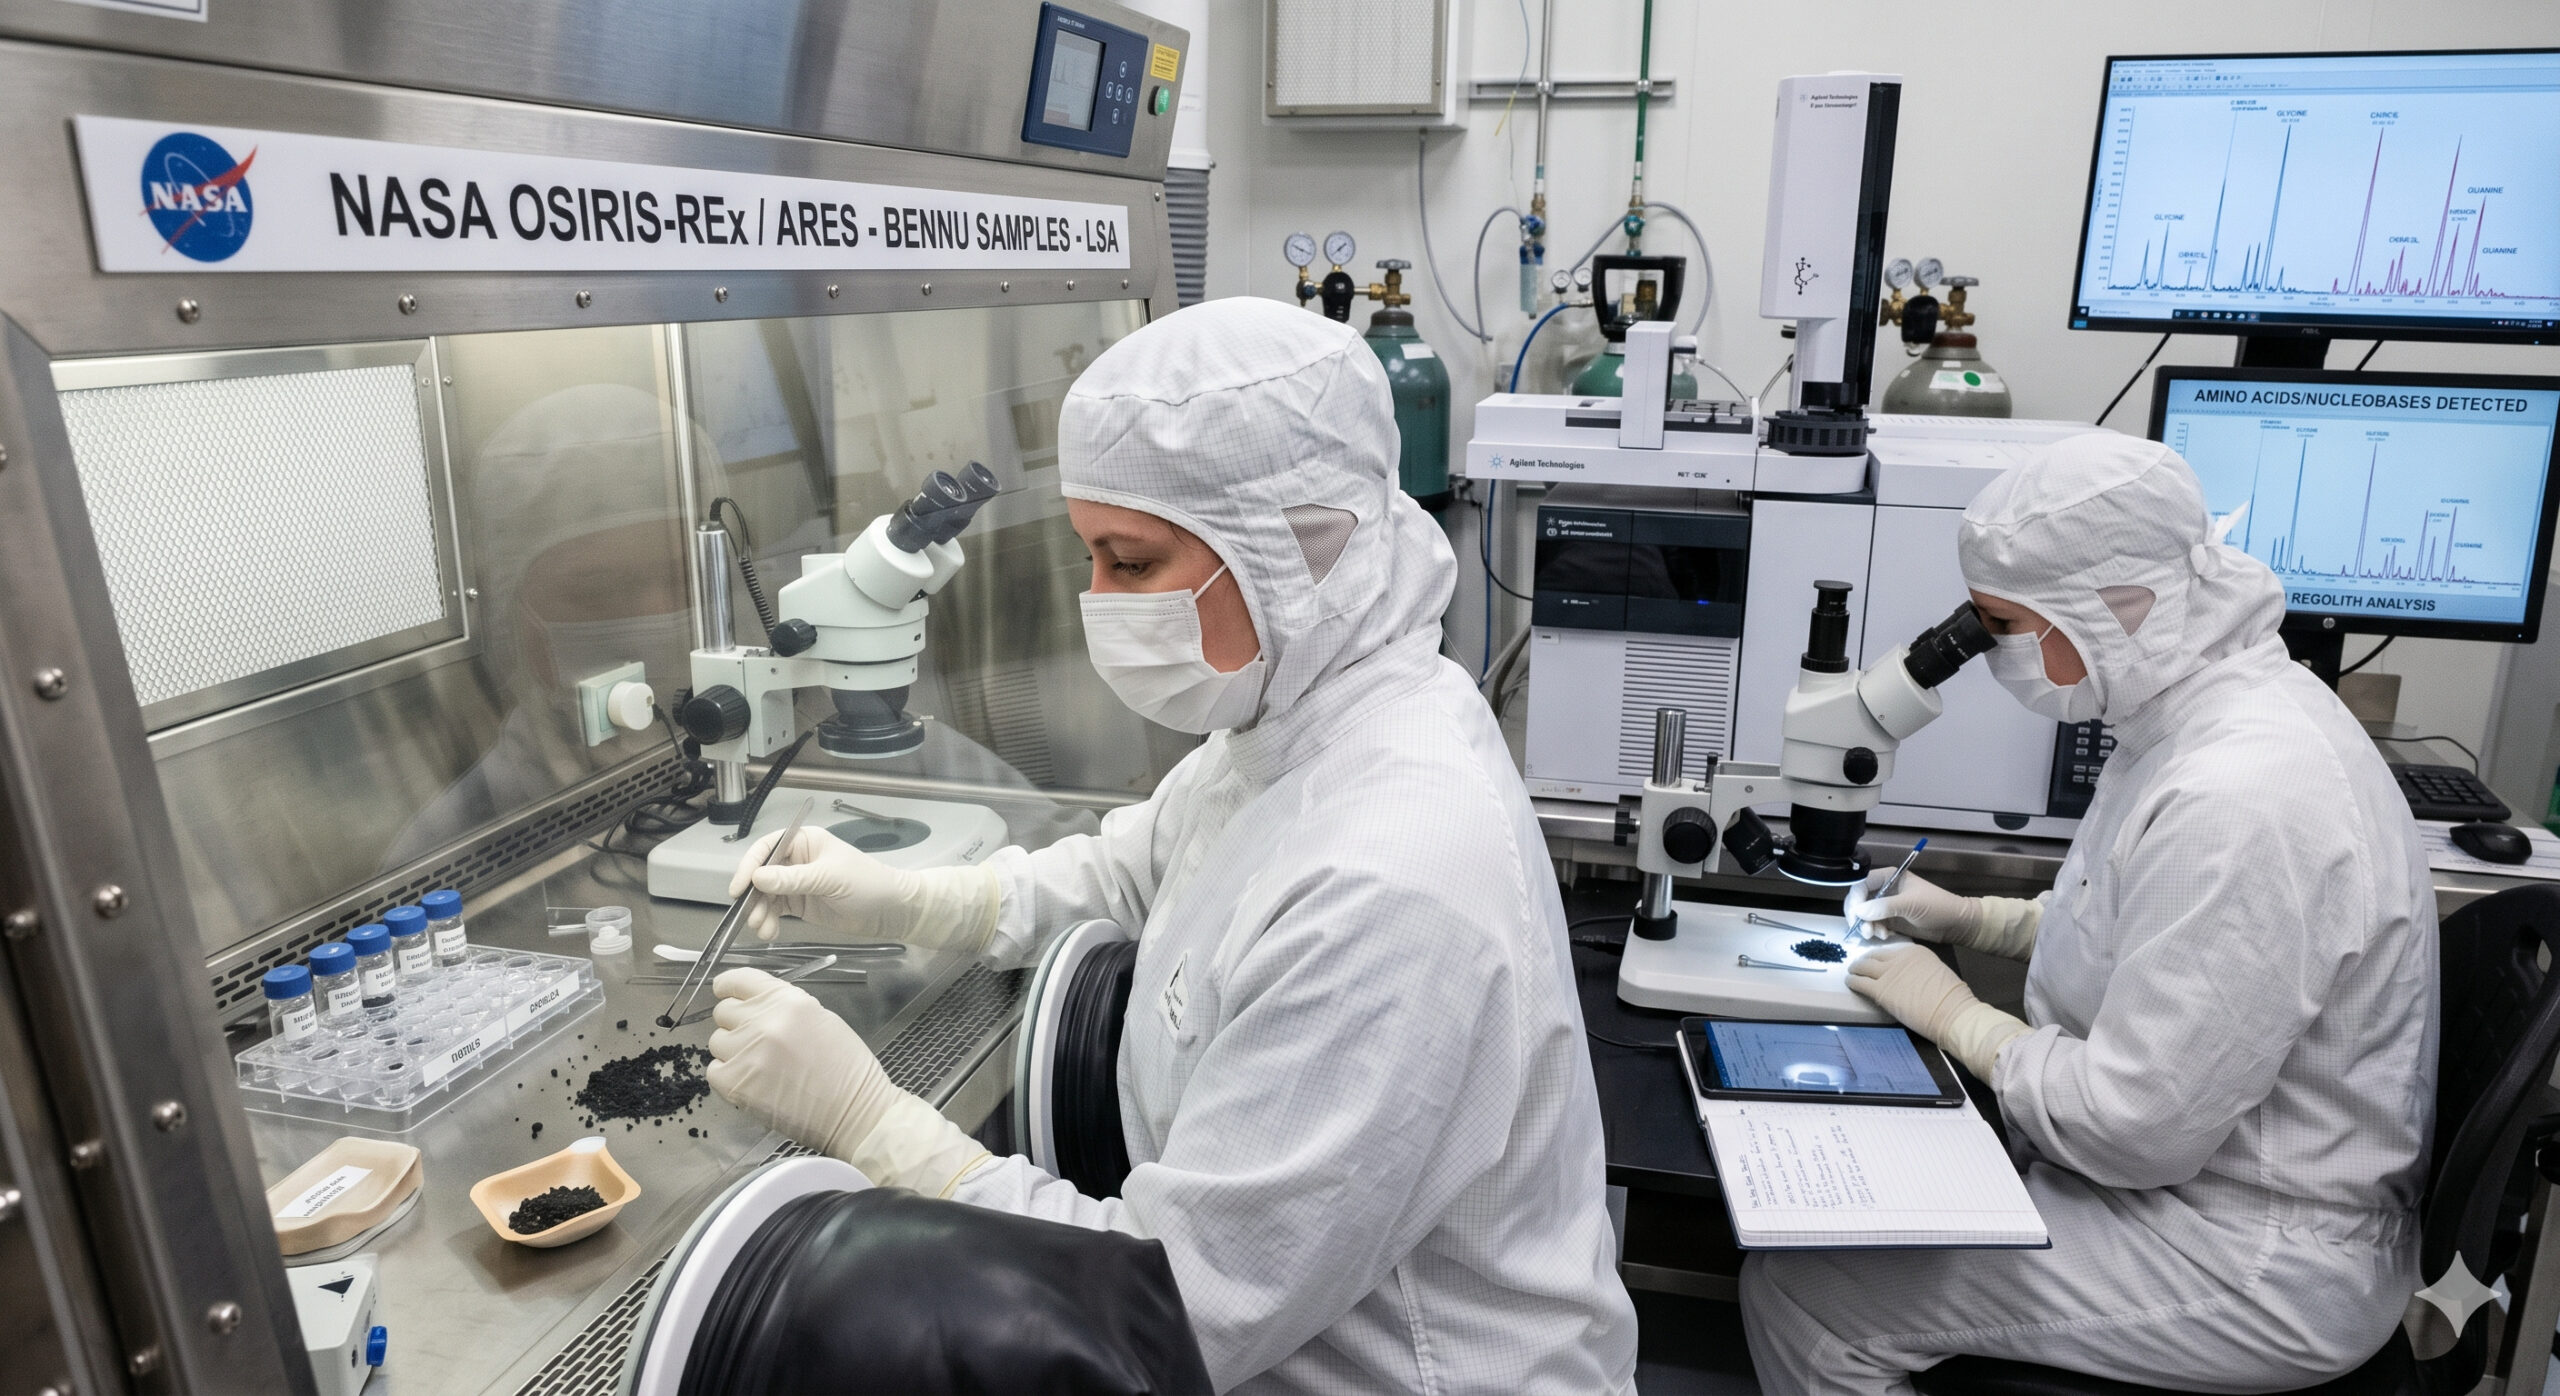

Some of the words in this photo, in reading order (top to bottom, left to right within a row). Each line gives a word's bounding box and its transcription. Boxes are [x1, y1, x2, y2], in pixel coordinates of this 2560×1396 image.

[149, 181, 249, 214] NASA
[330, 172, 499, 240] NASA
[509, 183, 749, 245] OSIRIS-REx
[758, 197, 765, 246] /
[776, 200, 859, 248] ARES
[868, 227, 877, 236] -
[883, 206, 970, 250] BENNU
[976, 212, 1071, 252] SAMPLES
[1075, 235, 1082, 243] -
[1085, 218, 1120, 253] LSA
[2194, 388, 2248, 404] AMINO
[2250, 390, 2432, 409] ACIDS/NUCLEOBASES
[2436, 396, 2528, 413] DETECTED
[1509, 458, 1536, 468] Agilent
[1537, 459, 1585, 471] Technologies
[2291, 592, 2363, 608] REGOLITH
[2366, 596, 2436, 612] ANALYSIS
